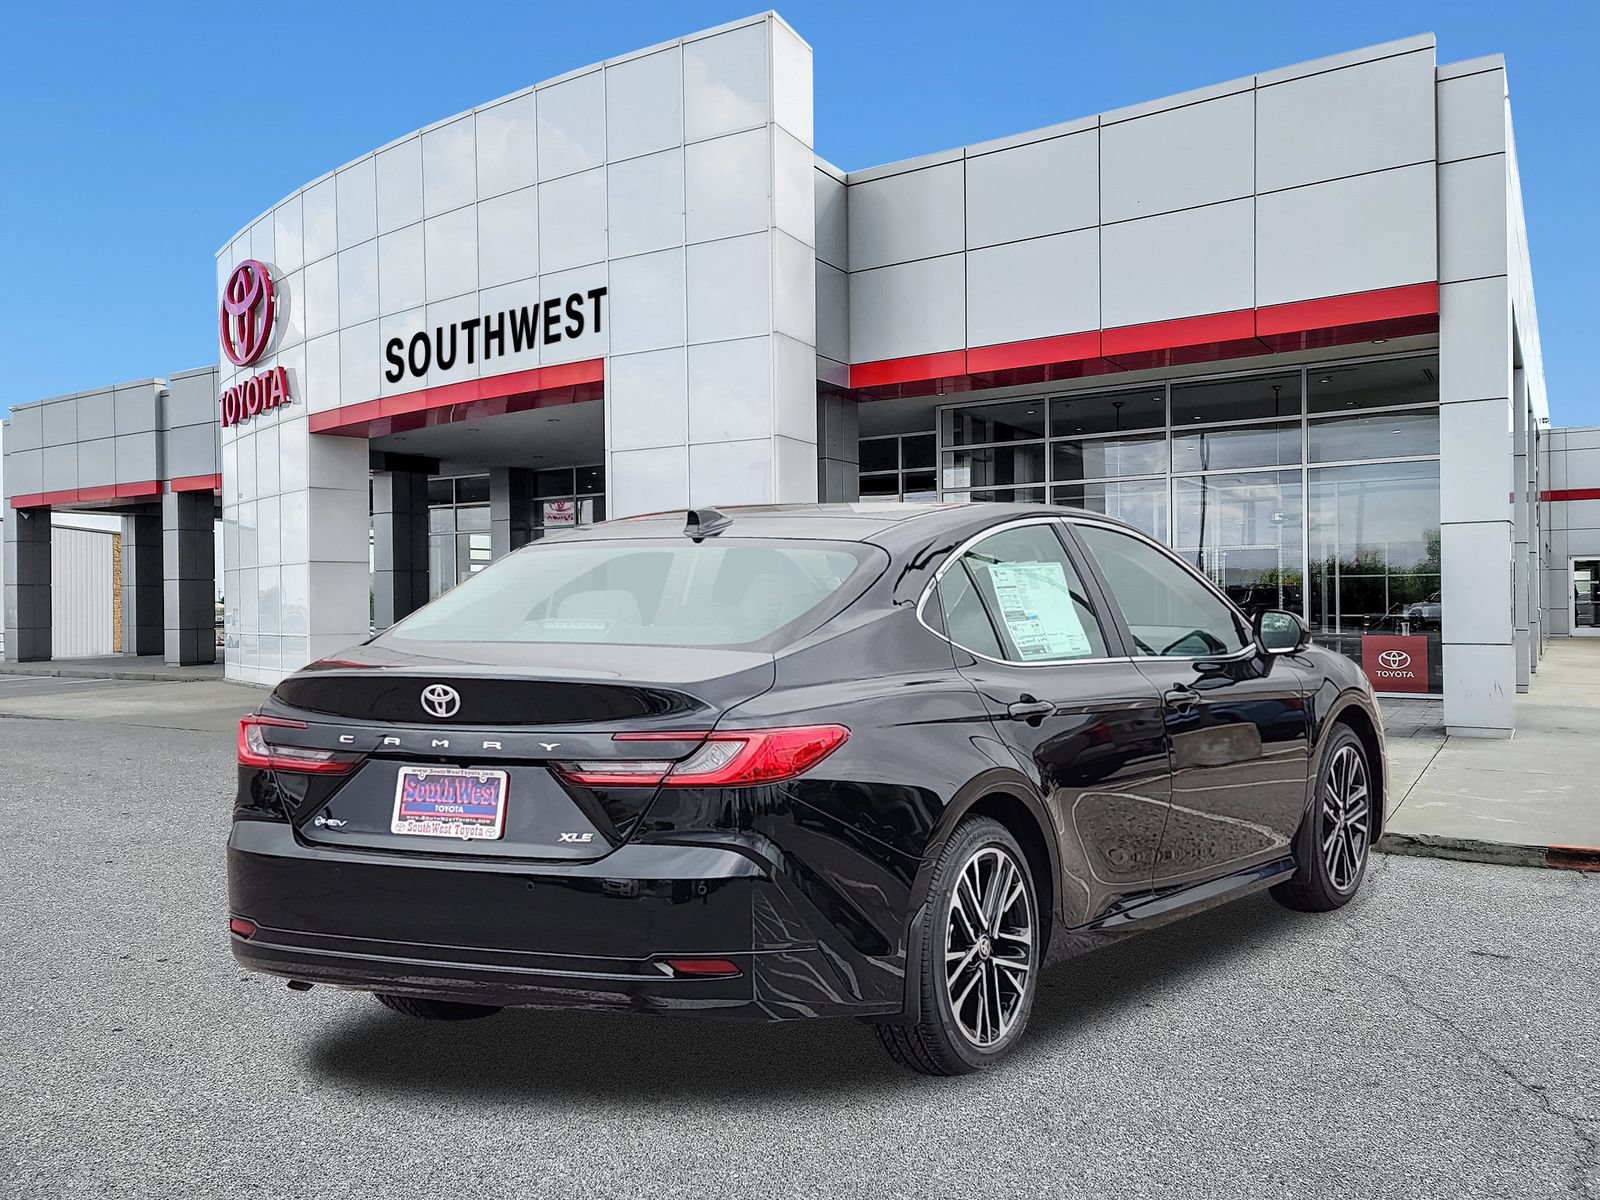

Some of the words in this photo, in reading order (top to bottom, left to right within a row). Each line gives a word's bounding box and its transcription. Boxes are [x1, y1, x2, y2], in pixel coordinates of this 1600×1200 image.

[385, 286, 608, 384] SOUTHWEST
[217, 366, 290, 428] TOYOTA
[1376, 670, 1415, 678] TOYOTA
[339, 734, 562, 751] CAMRY
[434, 804, 464, 813] TOYOTA
[455, 824, 484, 838] Toyota
[557, 832, 594, 843] XLE
